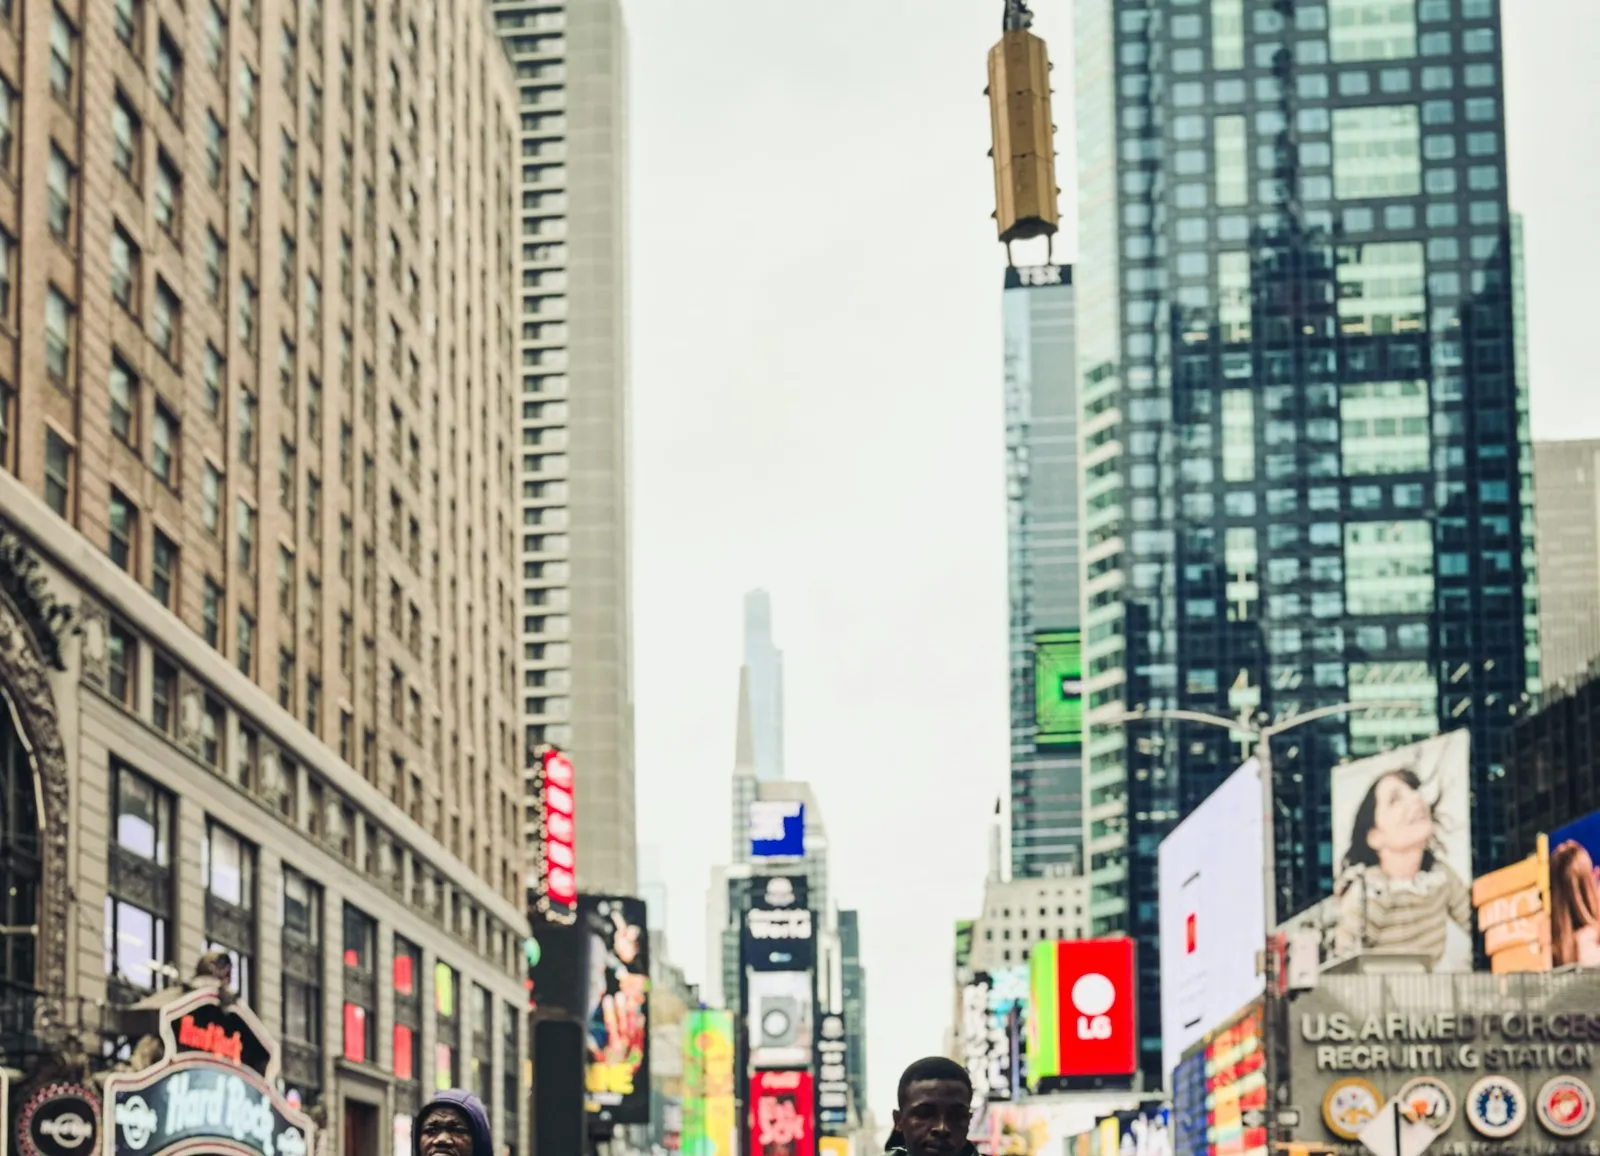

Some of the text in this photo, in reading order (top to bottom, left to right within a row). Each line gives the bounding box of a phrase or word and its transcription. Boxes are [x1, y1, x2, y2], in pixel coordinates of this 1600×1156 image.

[1077, 1015, 1112, 1040] LG
[1360, 1011, 1477, 1042] ARMED
[1316, 1044, 1594, 1071] RECRUITING STATION
[165, 1072, 227, 1136] Hard
[225, 1075, 275, 1156] Rock
